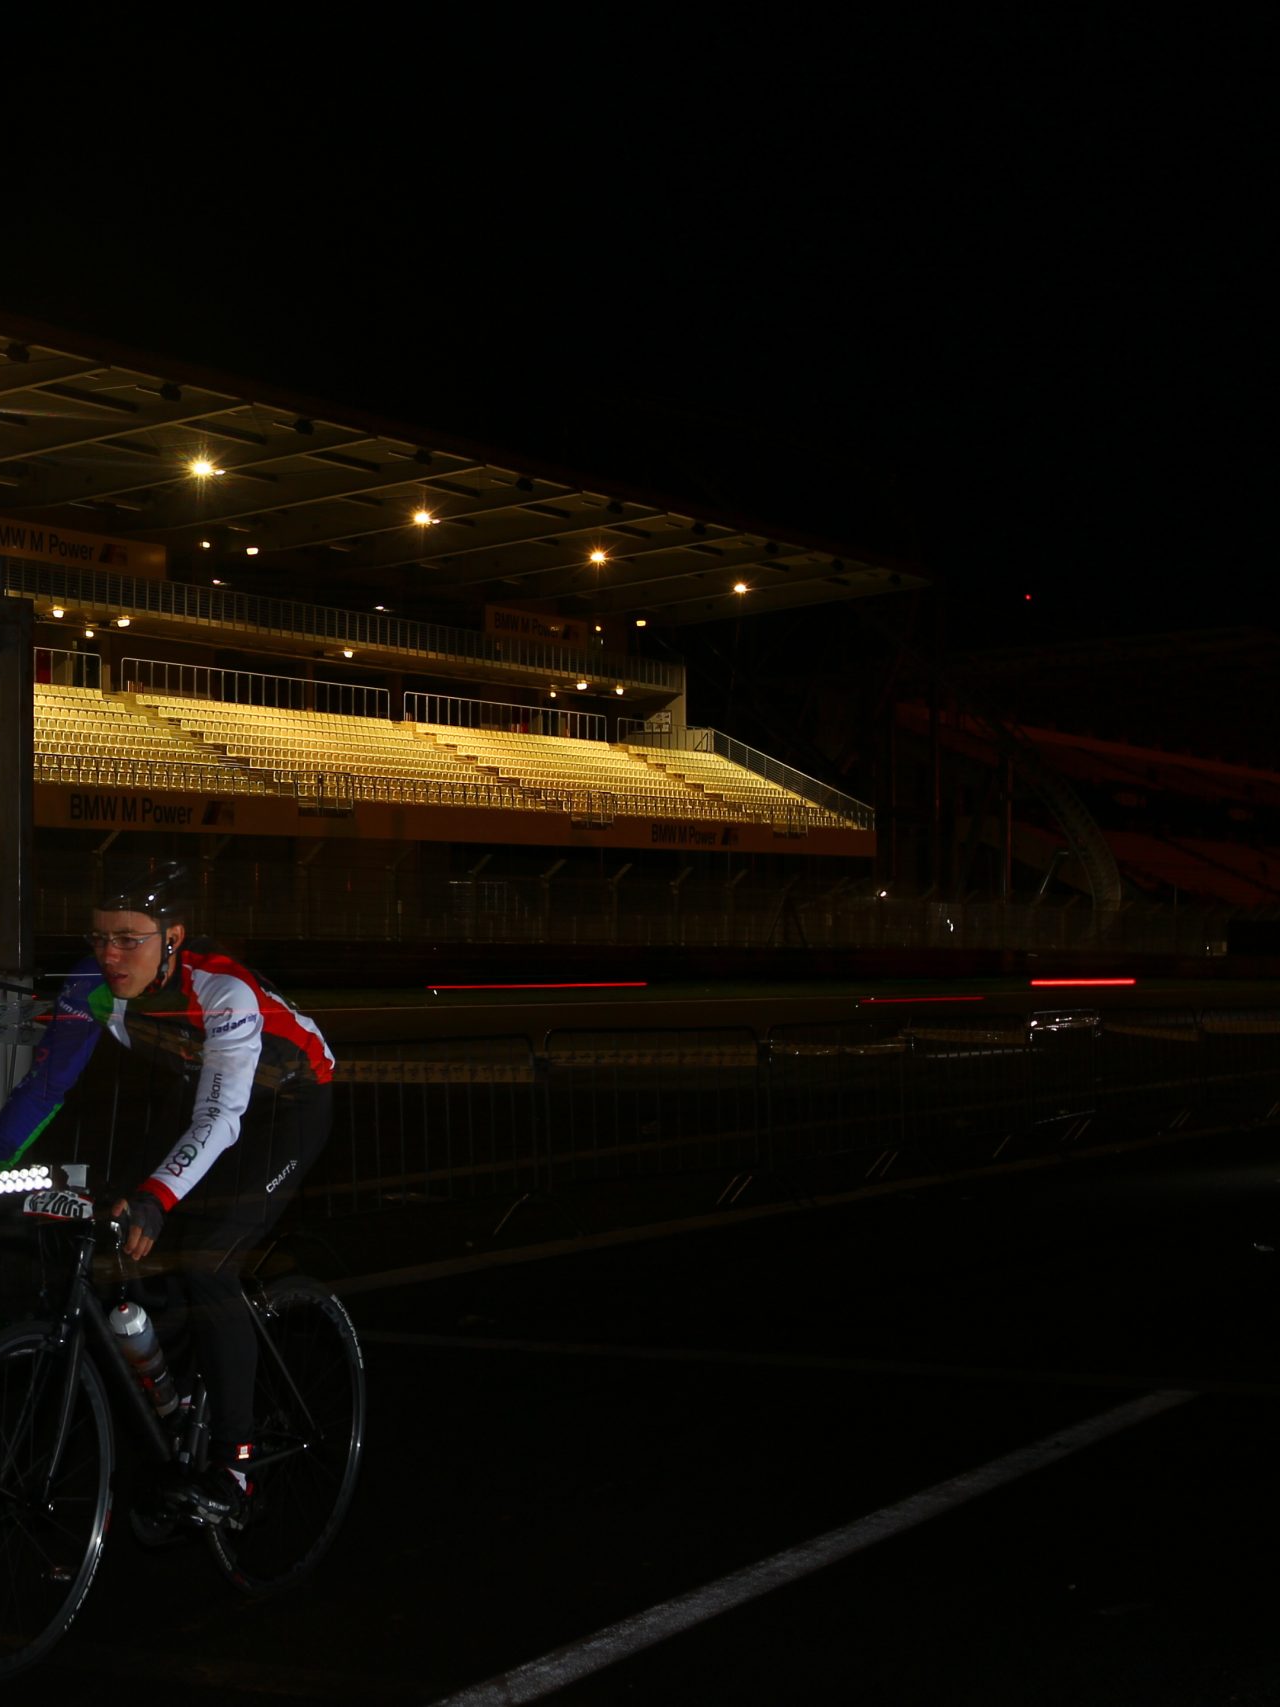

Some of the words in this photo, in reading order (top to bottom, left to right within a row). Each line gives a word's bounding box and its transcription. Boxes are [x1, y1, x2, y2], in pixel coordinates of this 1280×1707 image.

[30, 529, 44, 554] M
[49, 533, 95, 561] Power
[71, 793, 117, 822] BMW
[122, 796, 137, 824] M
[142, 797, 193, 825] Power
[652, 824, 677, 843] BMW
[206, 1073, 222, 1103] Team
[266, 1164, 290, 1193] CRAFT
